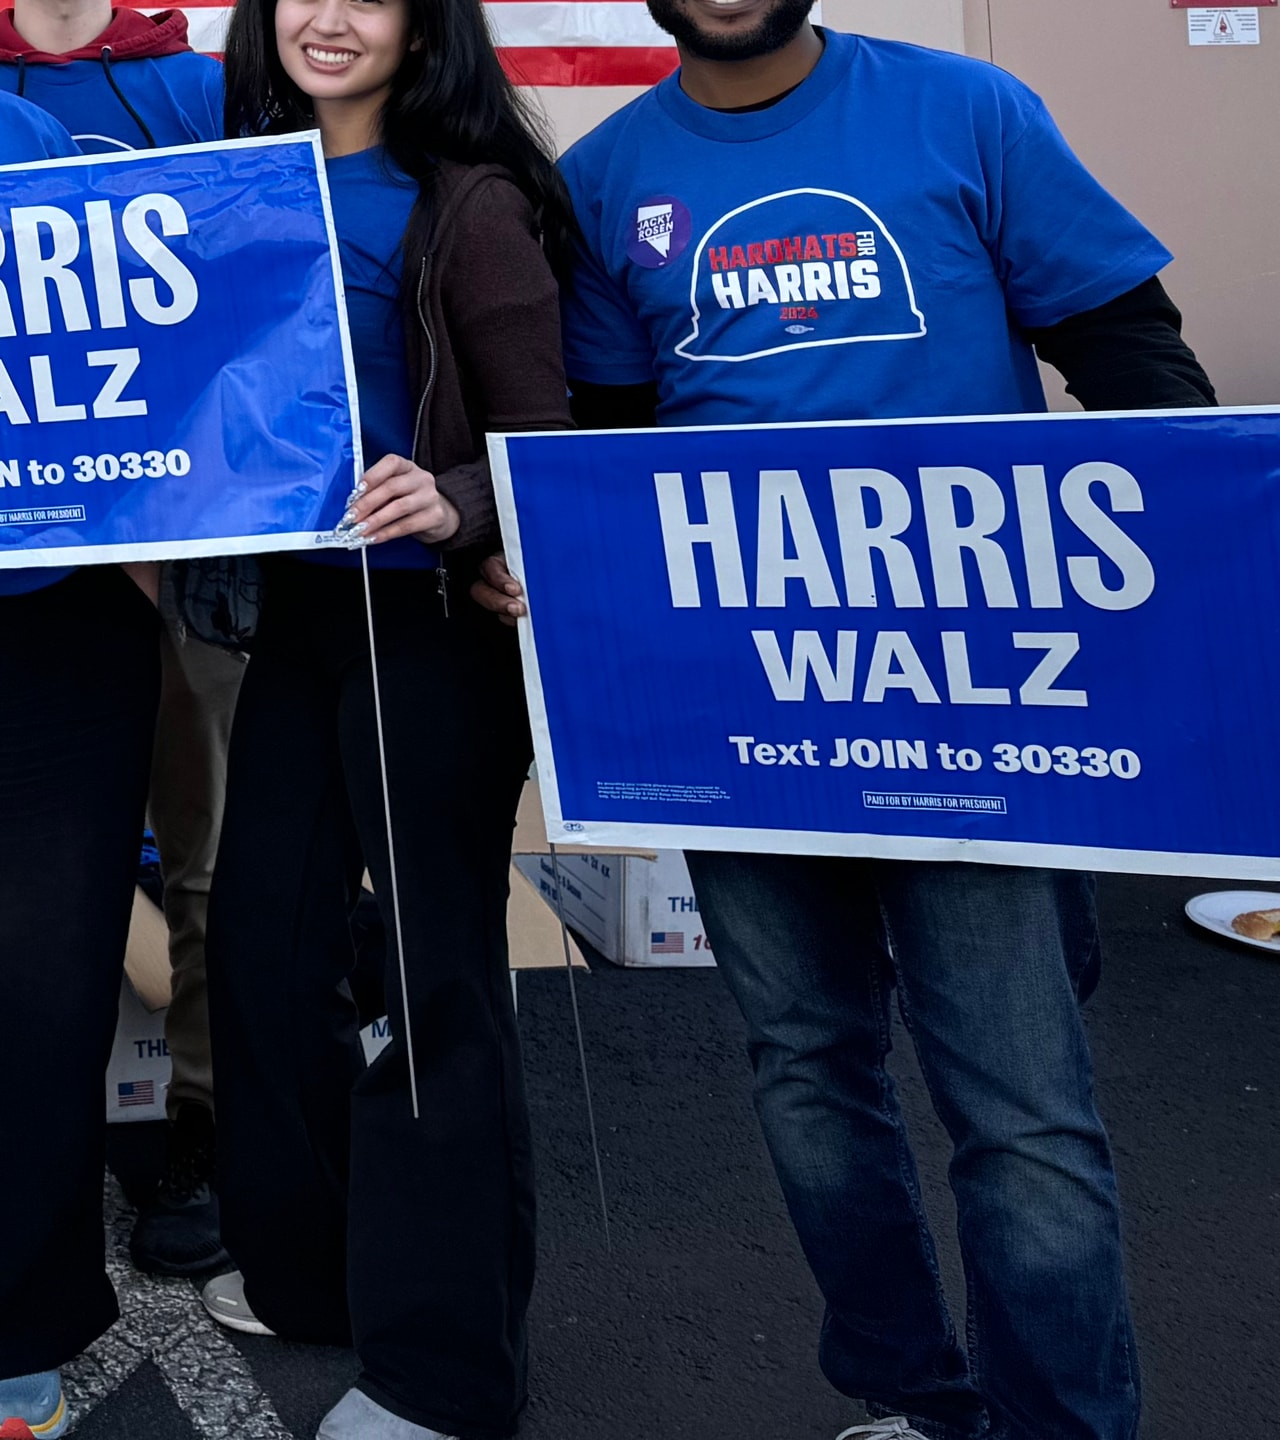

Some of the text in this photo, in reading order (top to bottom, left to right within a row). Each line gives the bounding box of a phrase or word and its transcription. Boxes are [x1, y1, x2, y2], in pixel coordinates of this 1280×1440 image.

[637, 212, 672, 230] JACKY
[638, 221, 674, 239] ROSEN
[708, 230, 877, 271] HARDHATS FOR
[711, 259, 881, 309] HARRIS
[779, 306, 819, 320] 2024
[27, 459, 65, 486] to
[72, 448, 191, 483] 30330
[0, 514, 8, 523] BY
[8, 511, 33, 522] HARRIS
[33, 510, 47, 520] FOR
[47, 508, 81, 519] PRESIDENT
[653, 461, 1156, 611] HARRIS
[750, 630, 1088, 708] WALZ
[728, 735, 1141, 780] Text JOIN to 30330
[866, 794, 1001, 810] PAID FOR BY HARRIS FOR PRESIDENT
